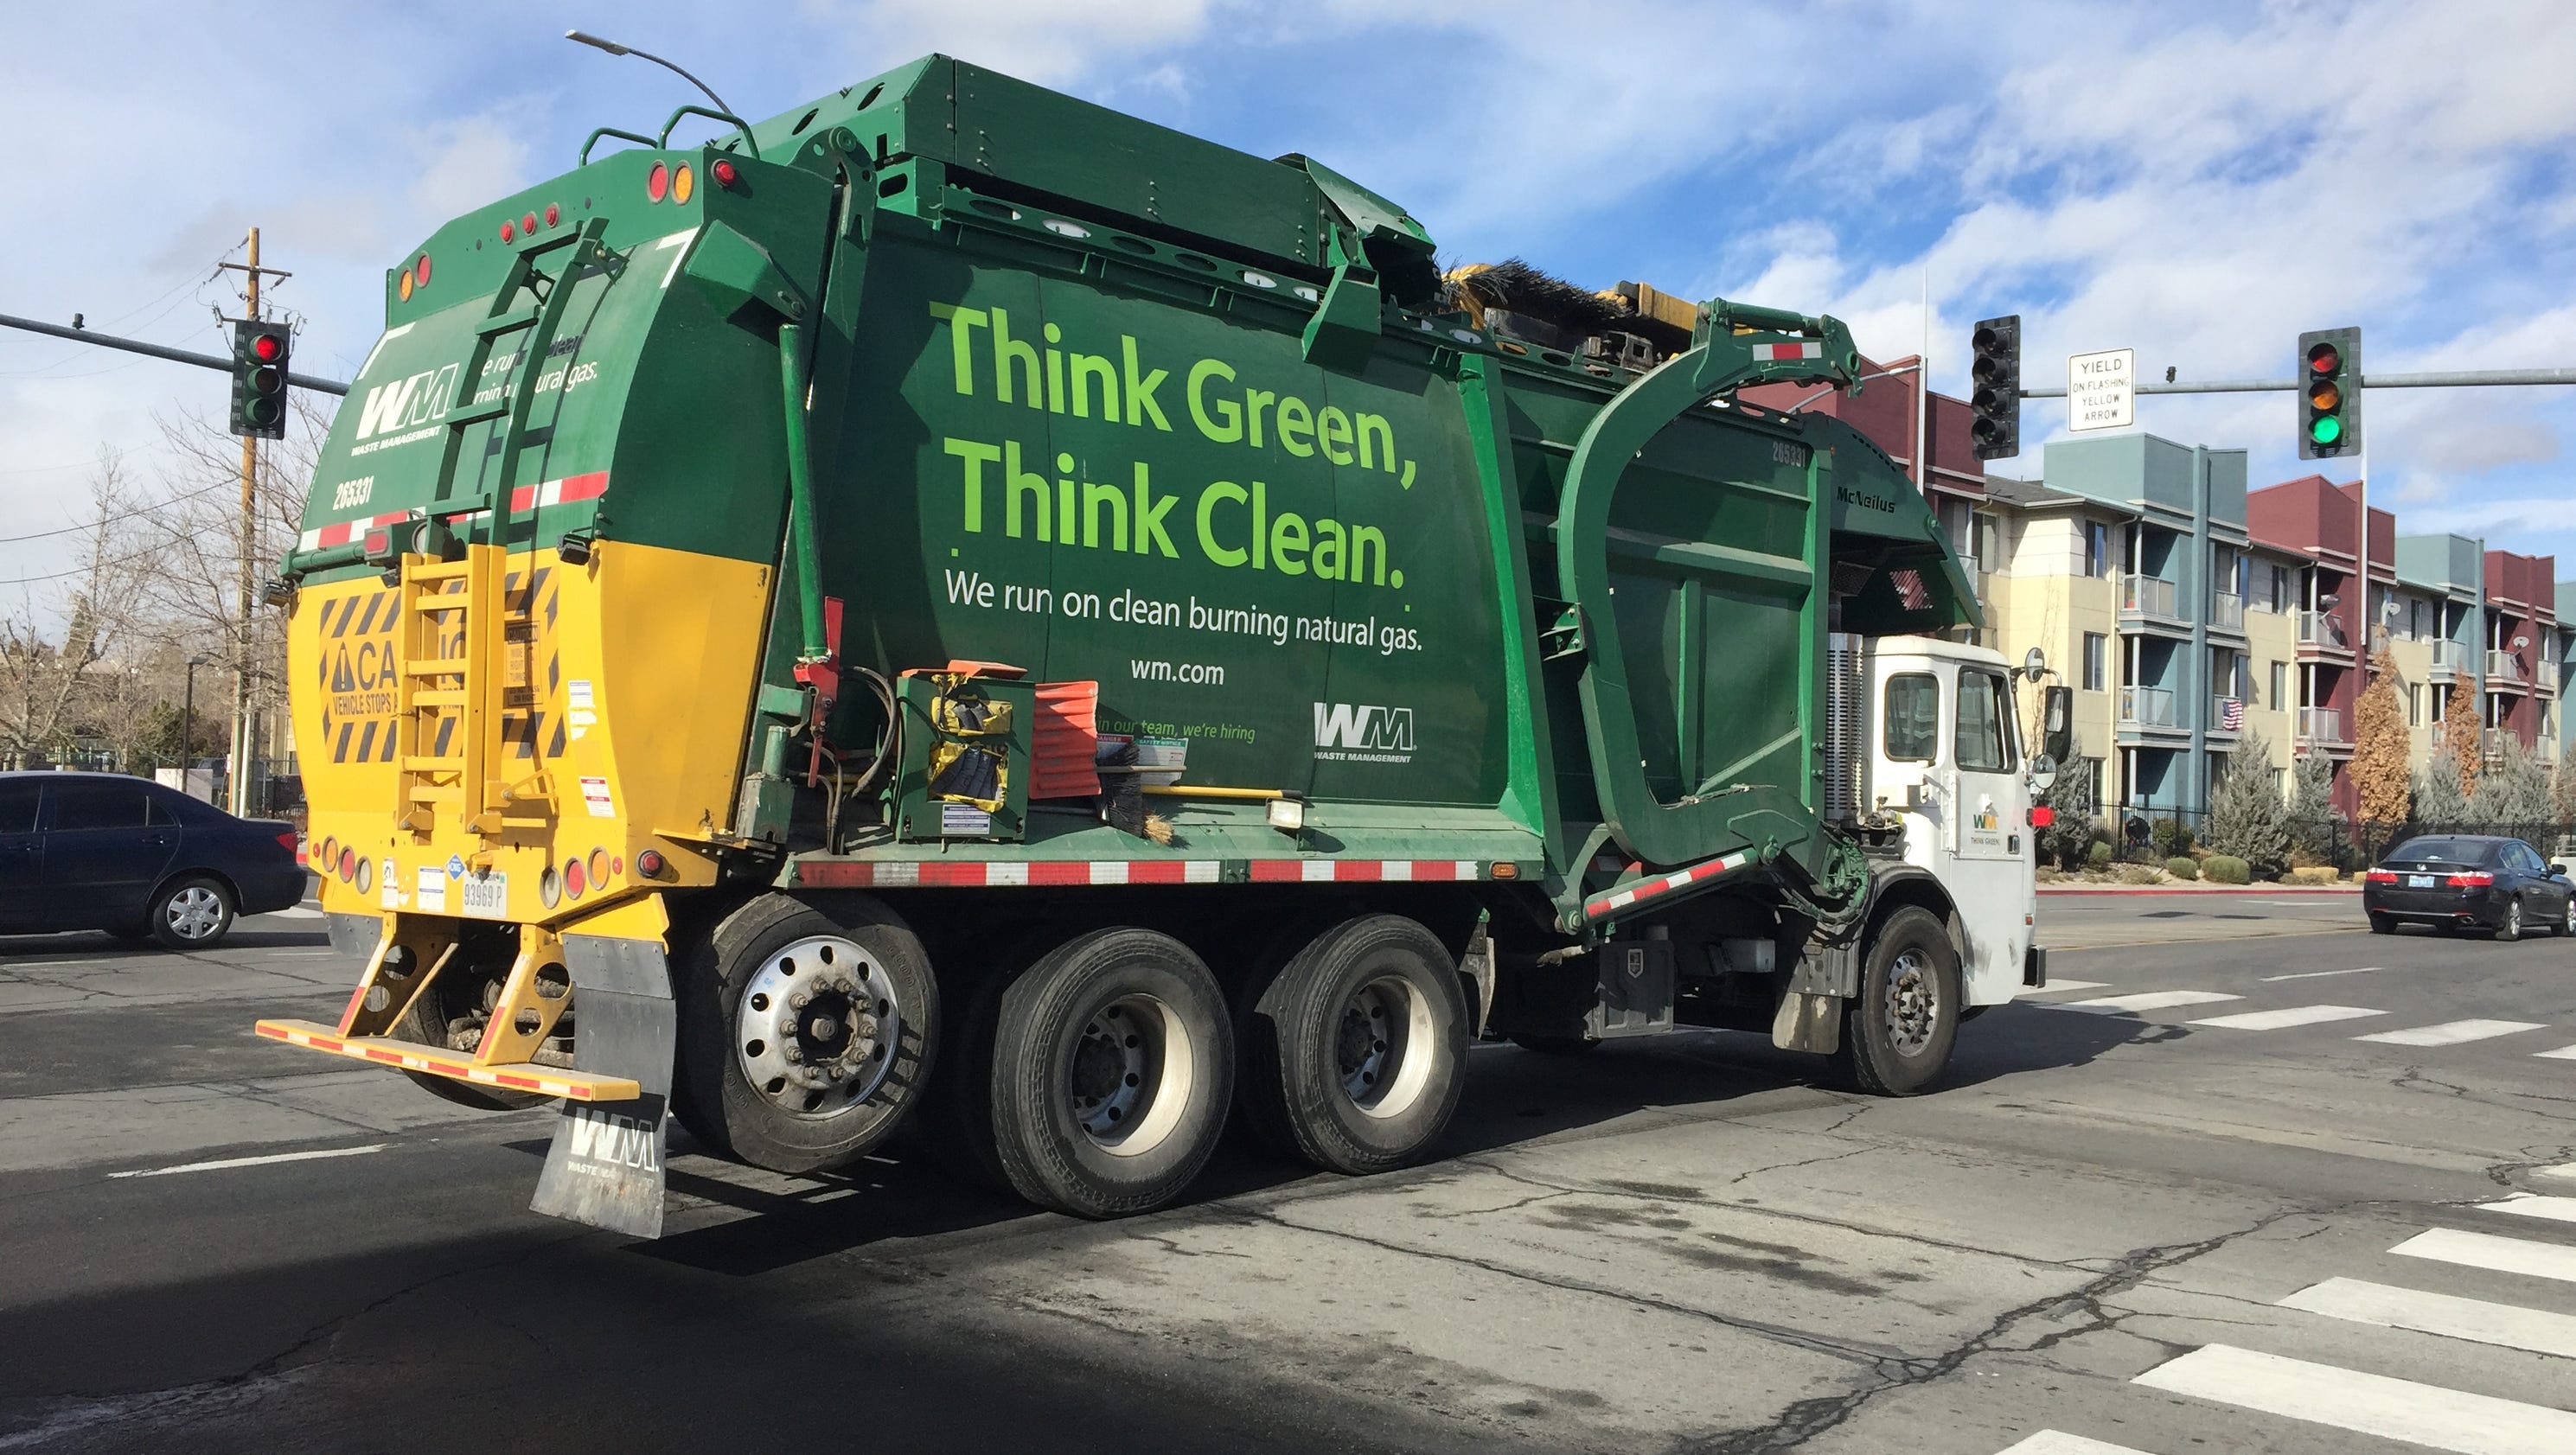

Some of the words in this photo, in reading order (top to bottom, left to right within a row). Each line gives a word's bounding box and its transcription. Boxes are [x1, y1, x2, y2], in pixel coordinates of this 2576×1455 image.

[564, 361, 598, 393] gas.
[2081, 358, 2122, 373] YIELD
[929, 301, 1173, 432] Think
[1186, 358, 1417, 490] Green,
[2073, 382, 2085, 393] ON
[2087, 377, 2130, 391] FLASHING
[355, 362, 460, 440] WM
[2082, 393, 2120, 406] YELLOW
[2085, 409, 2119, 422] ARROW
[351, 439, 379, 456] WASTE
[379, 425, 442, 451] MANAGEMENT
[1773, 440, 1806, 468] 265331
[332, 475, 374, 511] 265331
[1837, 485, 1896, 514] McNeilus
[943, 437, 1179, 559] Think
[1195, 480, 1405, 590] Clean.
[945, 569, 995, 608] We
[1004, 586, 1053, 615] run
[1063, 590, 1100, 619] on
[1109, 588, 1180, 628] clean
[1189, 596, 1288, 646] burning
[1296, 615, 1374, 647] natural
[1381, 624, 1423, 655] gas.
[1131, 659, 1224, 685] wm.com
[333, 696, 364, 716] VEHICLE
[366, 692, 391, 714] STOPS
[1114, 719, 1137, 732] our
[1141, 719, 1178, 737] team,
[1183, 721, 1218, 738] we're
[1221, 720, 1256, 744] hiring
[1314, 702, 1413, 750] WM
[1314, 751, 1346, 761] WASTE
[1347, 753, 1412, 763] MANAGEMENT
[464, 884, 493, 908] 93969
[496, 885, 502, 908] P
[571, 1106, 655, 1172] WM
[566, 1160, 598, 1177] WASTE
